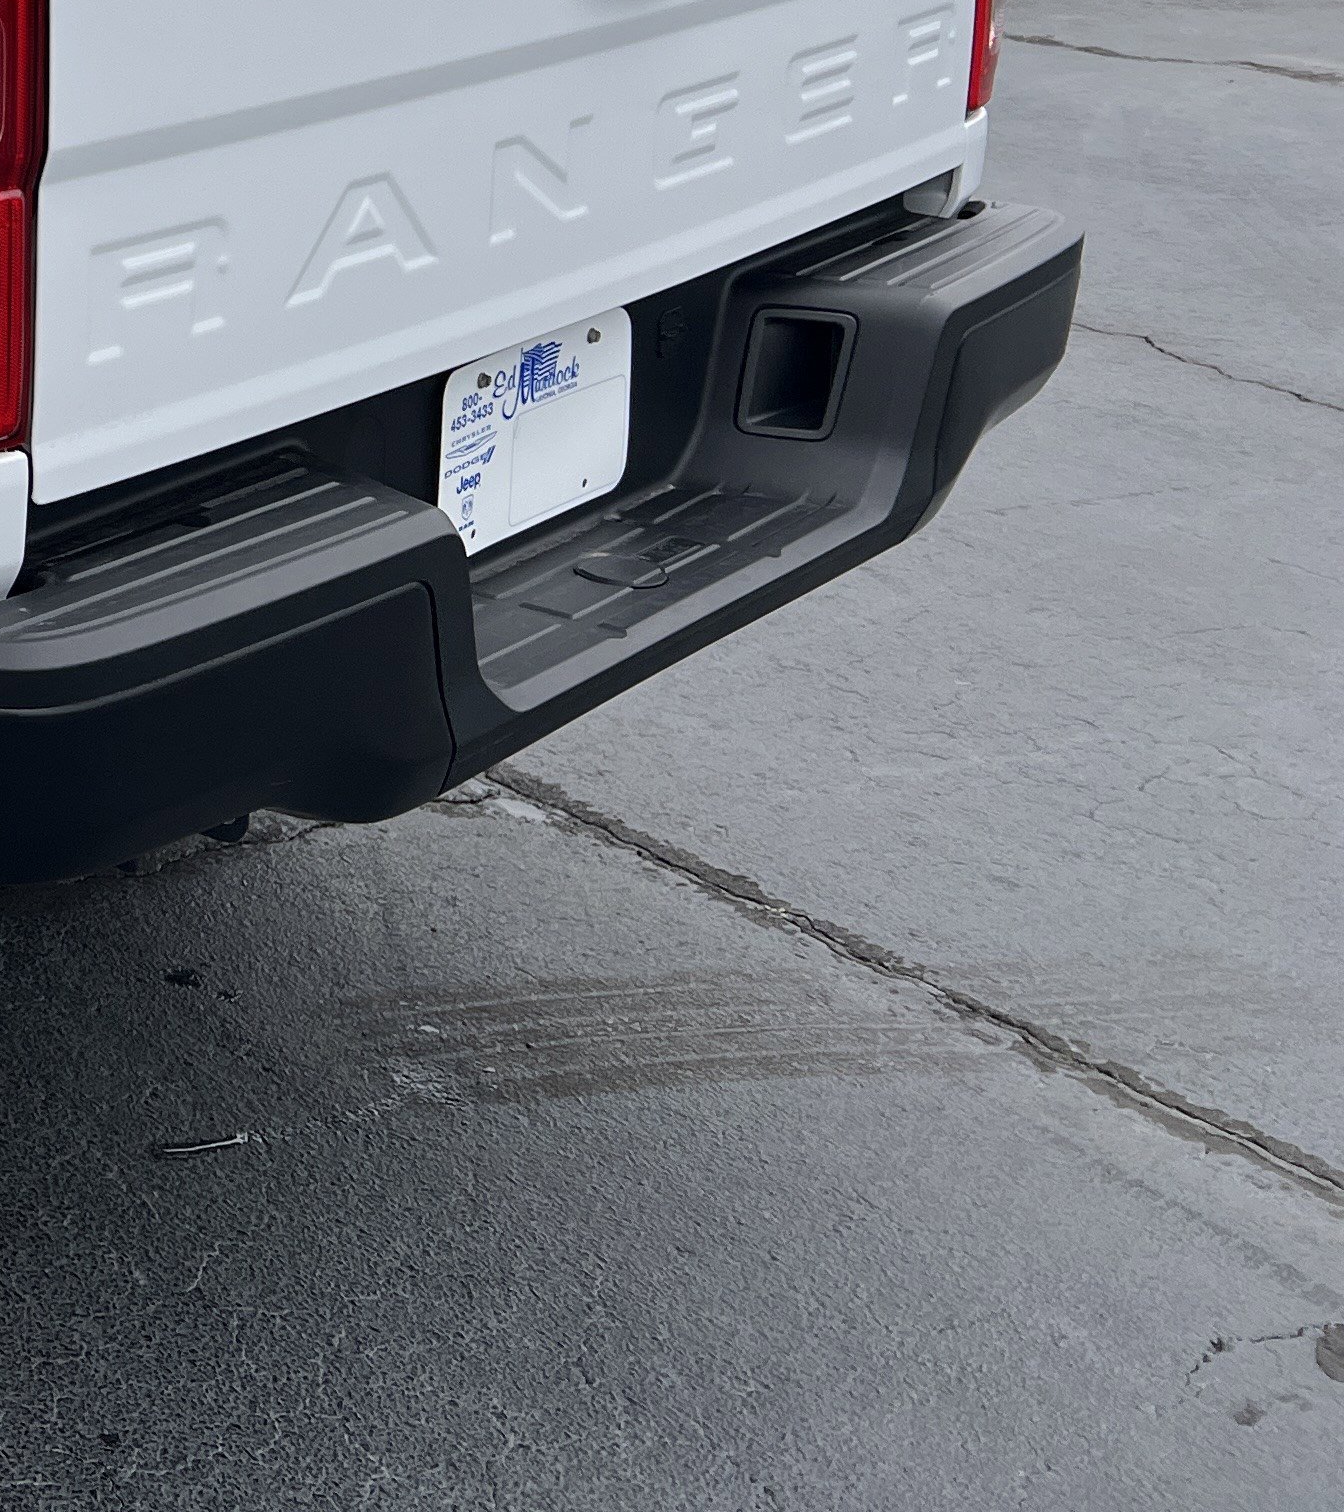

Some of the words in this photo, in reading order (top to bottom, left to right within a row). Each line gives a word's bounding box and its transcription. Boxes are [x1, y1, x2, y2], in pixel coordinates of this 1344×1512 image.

[86, 0, 957, 367] RANGER
[492, 364, 517, 398] Ed
[461, 392, 483, 412] 800-
[450, 401, 494, 433] 453-3433
[451, 424, 492, 447] CHRYSLER
[456, 472, 481, 494] Jeep
